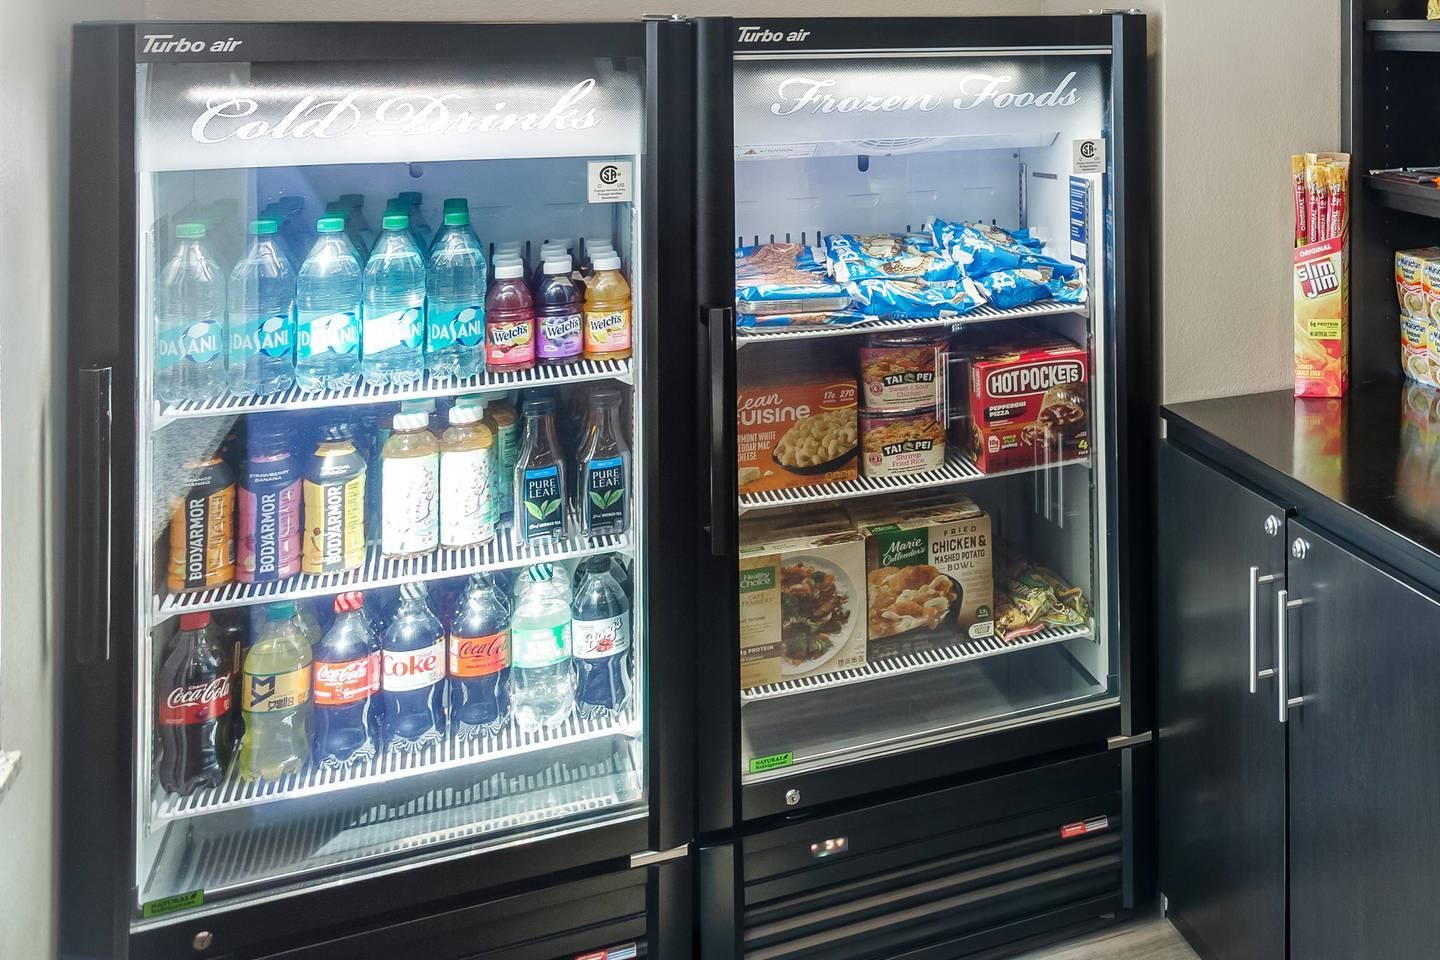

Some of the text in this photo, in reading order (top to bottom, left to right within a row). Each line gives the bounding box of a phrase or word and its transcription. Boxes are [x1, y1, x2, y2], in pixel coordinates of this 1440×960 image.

[737, 26, 810, 43] Turbo air
[141, 34, 243, 54] Turbo air
[770, 71, 1081, 116] Frozen Foods
[191, 78, 602, 144] Cold Drinks
[1299, 244, 1332, 257] ORIGINAL
[547, 318, 579, 337] Welch's
[590, 314, 621, 331] Welch's
[431, 320, 481, 344] DASANI
[494, 324, 527, 342] Welch's
[159, 332, 216, 360] DASANI
[232, 329, 288, 354] DASANI
[885, 372, 932, 385] TAI PEI
[840, 390, 854, 398] 270
[989, 410, 1010, 418] PIZZA
[884, 441, 931, 454] TAI PEI
[593, 468, 619, 479] PURE
[529, 478, 555, 489] PURE
[593, 478, 619, 488] LEAF
[530, 488, 556, 499] LEAF
[326, 485, 343, 564] BODYARMOR
[943, 525, 977, 537] FRIED
[189, 497, 205, 581] BODYARMOR
[259, 493, 276, 574] BODYARMOR
[883, 538, 923, 556] Marie
[932, 535, 986, 554] CHICKEN &
[934, 550, 985, 564] MASHED POTATO
[947, 561, 975, 571] BOWL
[748, 645, 774, 655] PROTEIN
[382, 653, 436, 676] Coke
[756, 757, 783, 765] NATURAL
